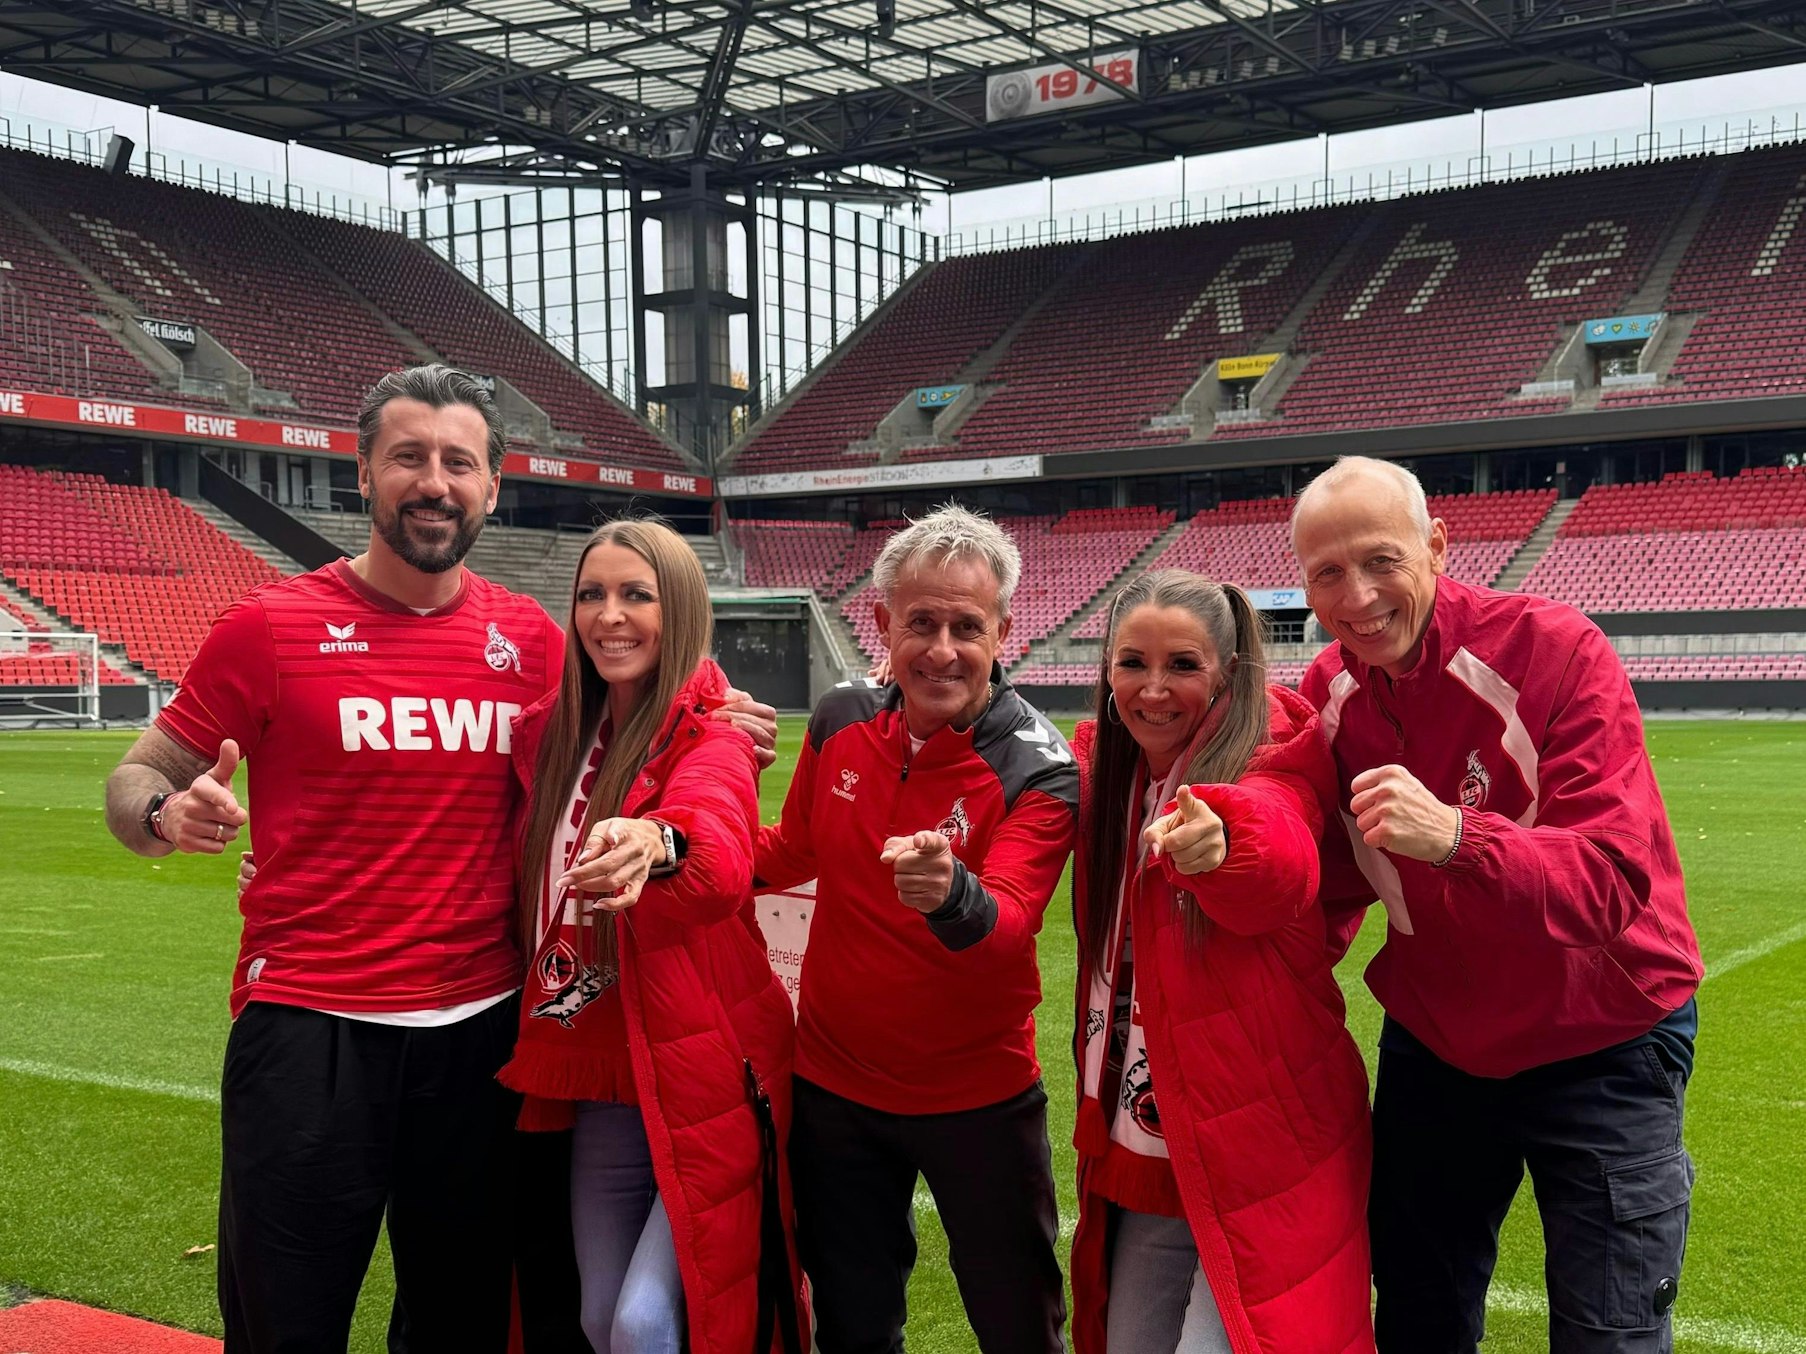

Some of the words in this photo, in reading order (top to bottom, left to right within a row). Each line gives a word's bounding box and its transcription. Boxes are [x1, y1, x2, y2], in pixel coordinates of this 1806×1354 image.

[1035, 59, 1133, 102] 1978
[78, 401, 136, 426] REWE
[184, 413, 237, 438] REWE
[281, 426, 331, 449] REWE
[529, 457, 568, 478] REWE
[599, 467, 635, 486] REWE
[663, 474, 697, 493] REWE
[319, 640, 369, 653] erima
[831, 785, 856, 802] hummel
